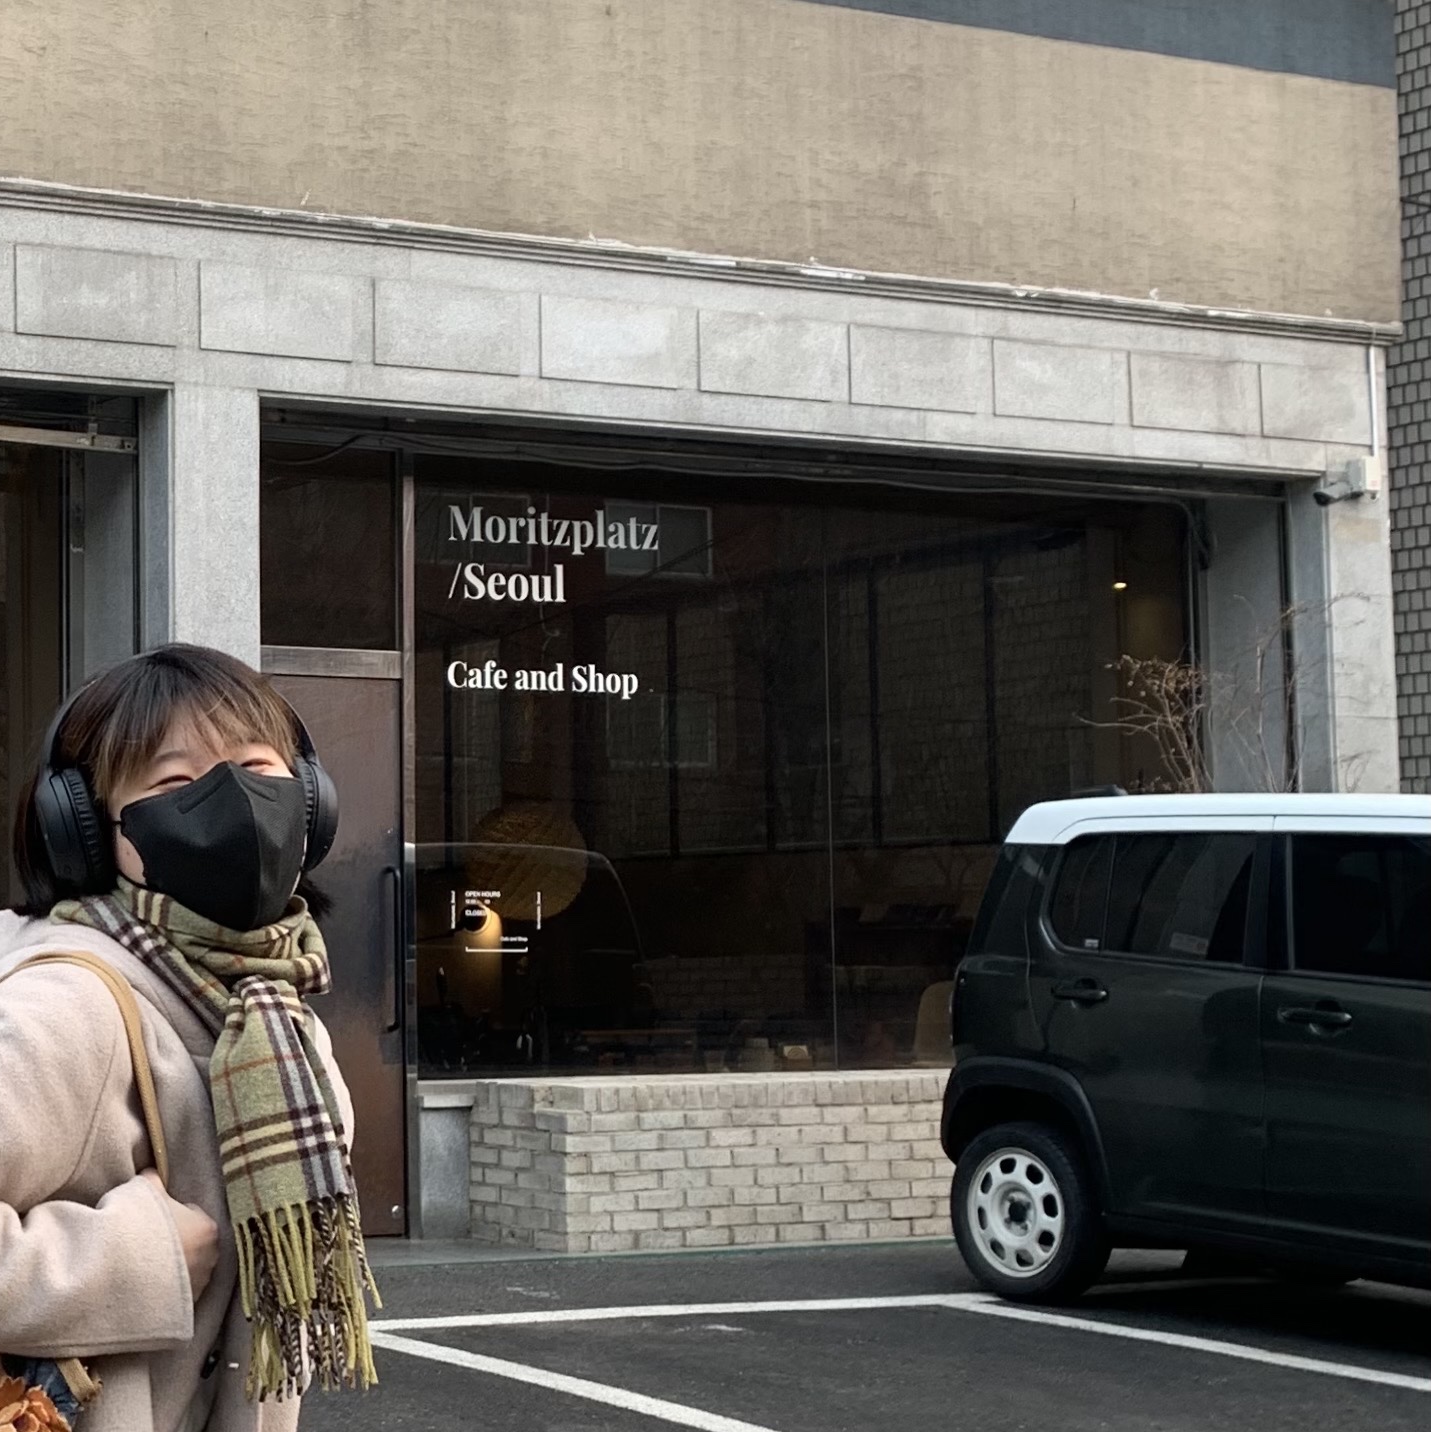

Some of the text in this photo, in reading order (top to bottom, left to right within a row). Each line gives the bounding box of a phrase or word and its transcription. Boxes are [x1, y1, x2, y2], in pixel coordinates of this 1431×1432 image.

[448, 505, 659, 555] Moritzplatz
[448, 562, 566, 603] /Seoul
[447, 660, 638, 699] Cafe and Shop
